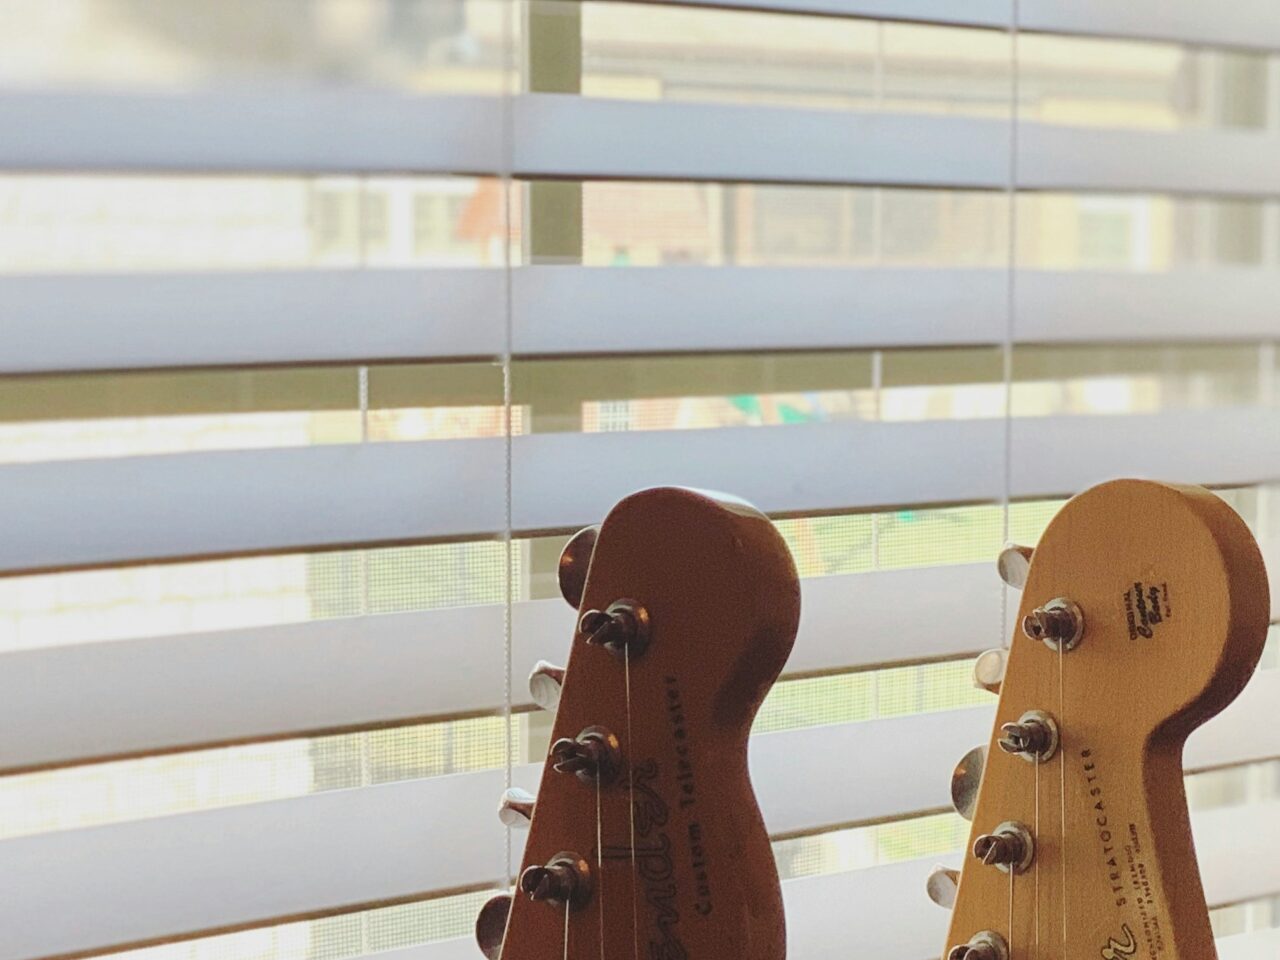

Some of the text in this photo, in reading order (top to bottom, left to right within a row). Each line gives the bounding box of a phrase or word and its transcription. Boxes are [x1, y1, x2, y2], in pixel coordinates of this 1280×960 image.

[664, 675, 714, 917] Custom Telecaster
[1081, 747, 1127, 908] STRATOCASTER
